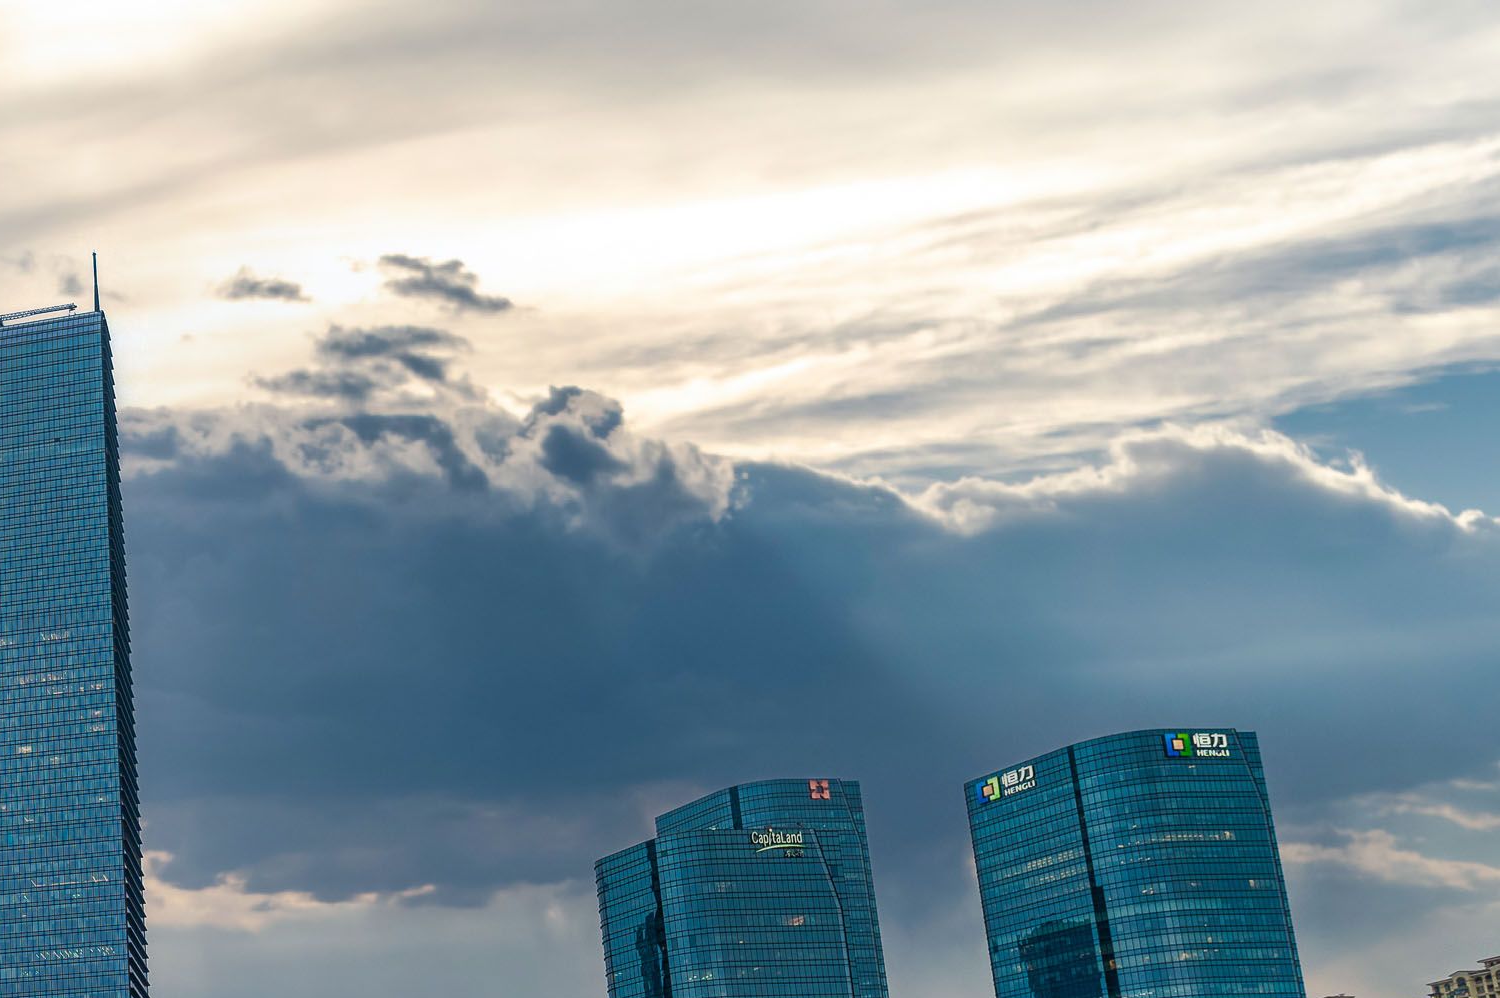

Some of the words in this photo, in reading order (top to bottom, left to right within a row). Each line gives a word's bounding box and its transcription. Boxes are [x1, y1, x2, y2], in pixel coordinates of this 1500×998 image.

[1192, 732, 1228, 748] 恒力
[1196, 749, 1230, 757] HENGLI
[1001, 765, 1034, 788] 恒力
[1004, 779, 1036, 796] HENGLI
[751, 828, 803, 847] CapitaLand
